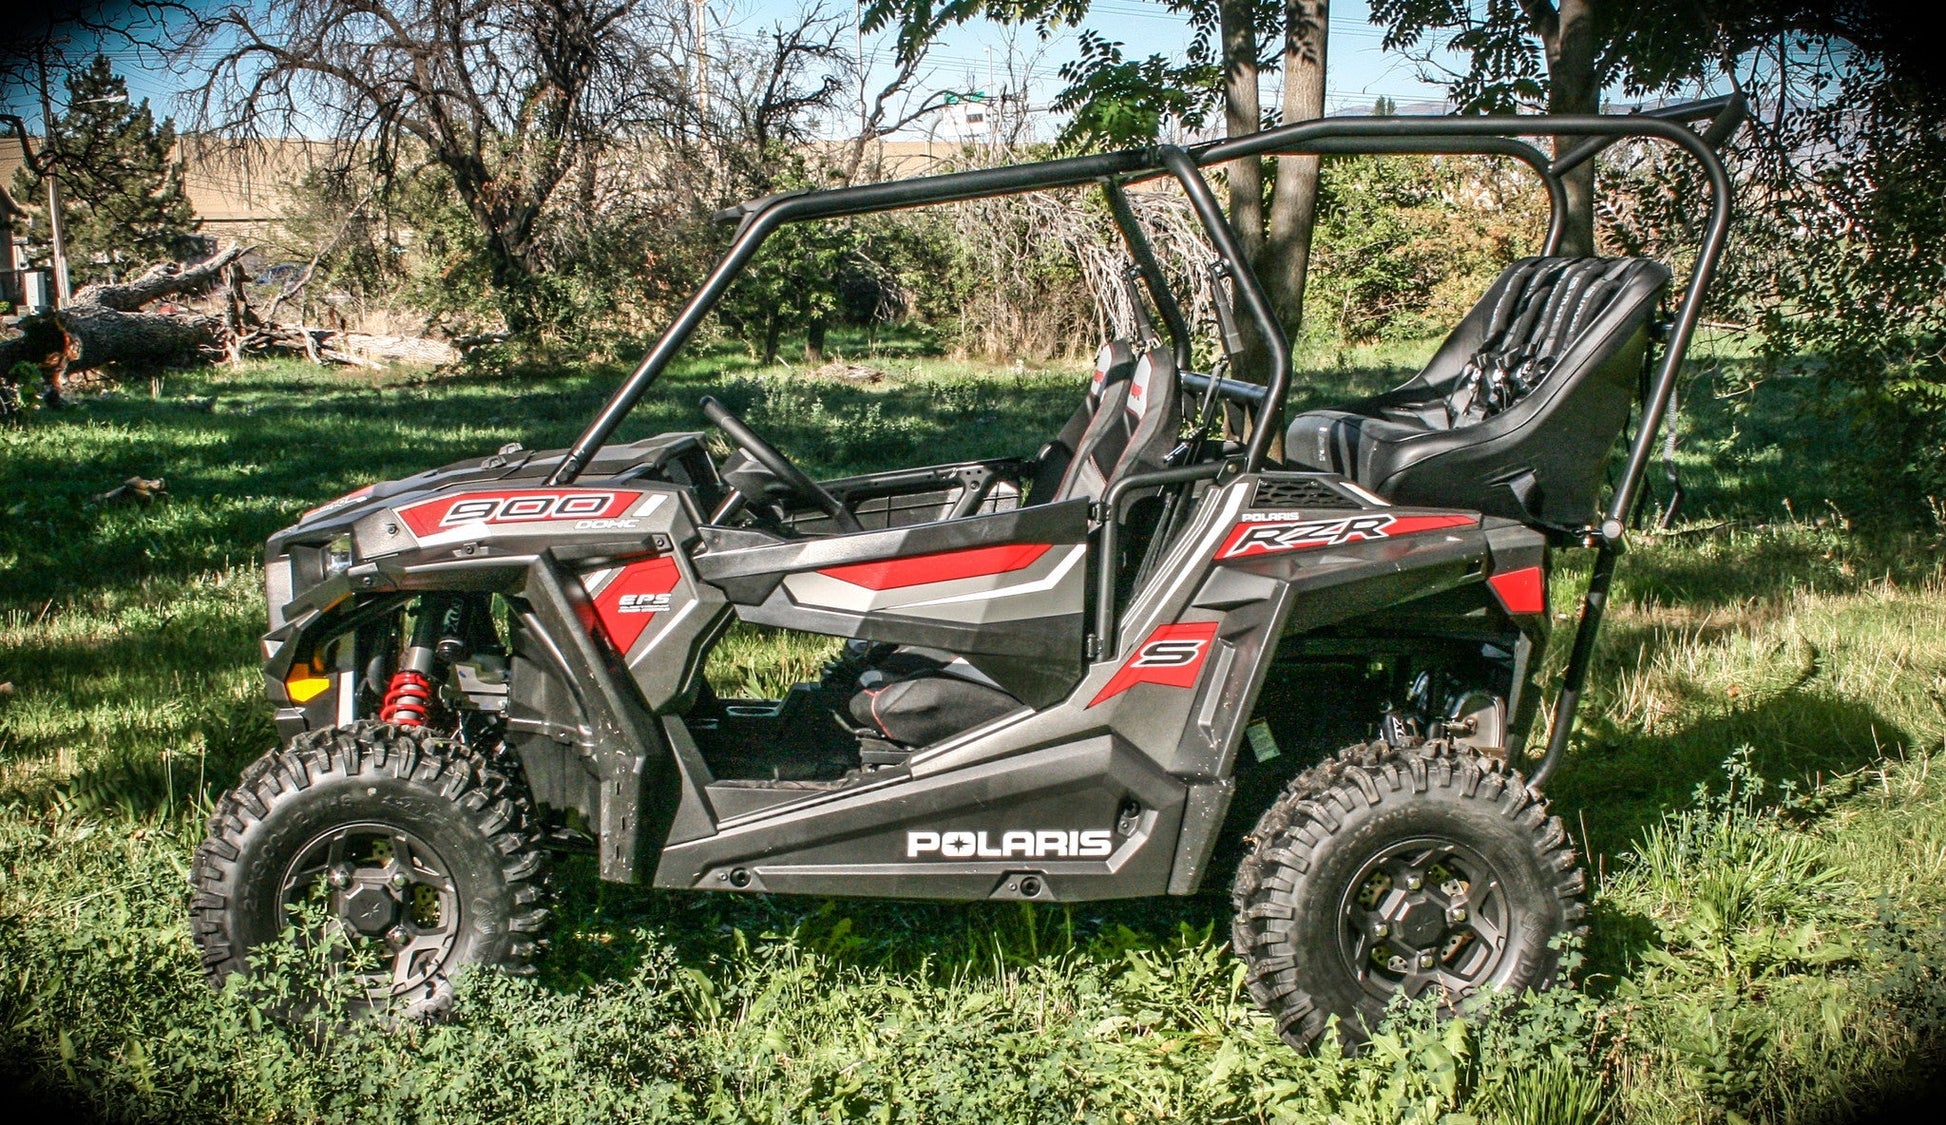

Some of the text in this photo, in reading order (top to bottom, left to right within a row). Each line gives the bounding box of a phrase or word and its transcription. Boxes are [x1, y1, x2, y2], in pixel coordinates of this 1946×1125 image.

[438, 493, 615, 527] 900
[1242, 512, 1300, 522] POLARIS
[574, 519, 640, 530] DOHC
[1226, 513, 1398, 557] RZR
[618, 593, 672, 606] EPS
[1130, 640, 1205, 668] S
[906, 830, 1113, 858] POLARIS
